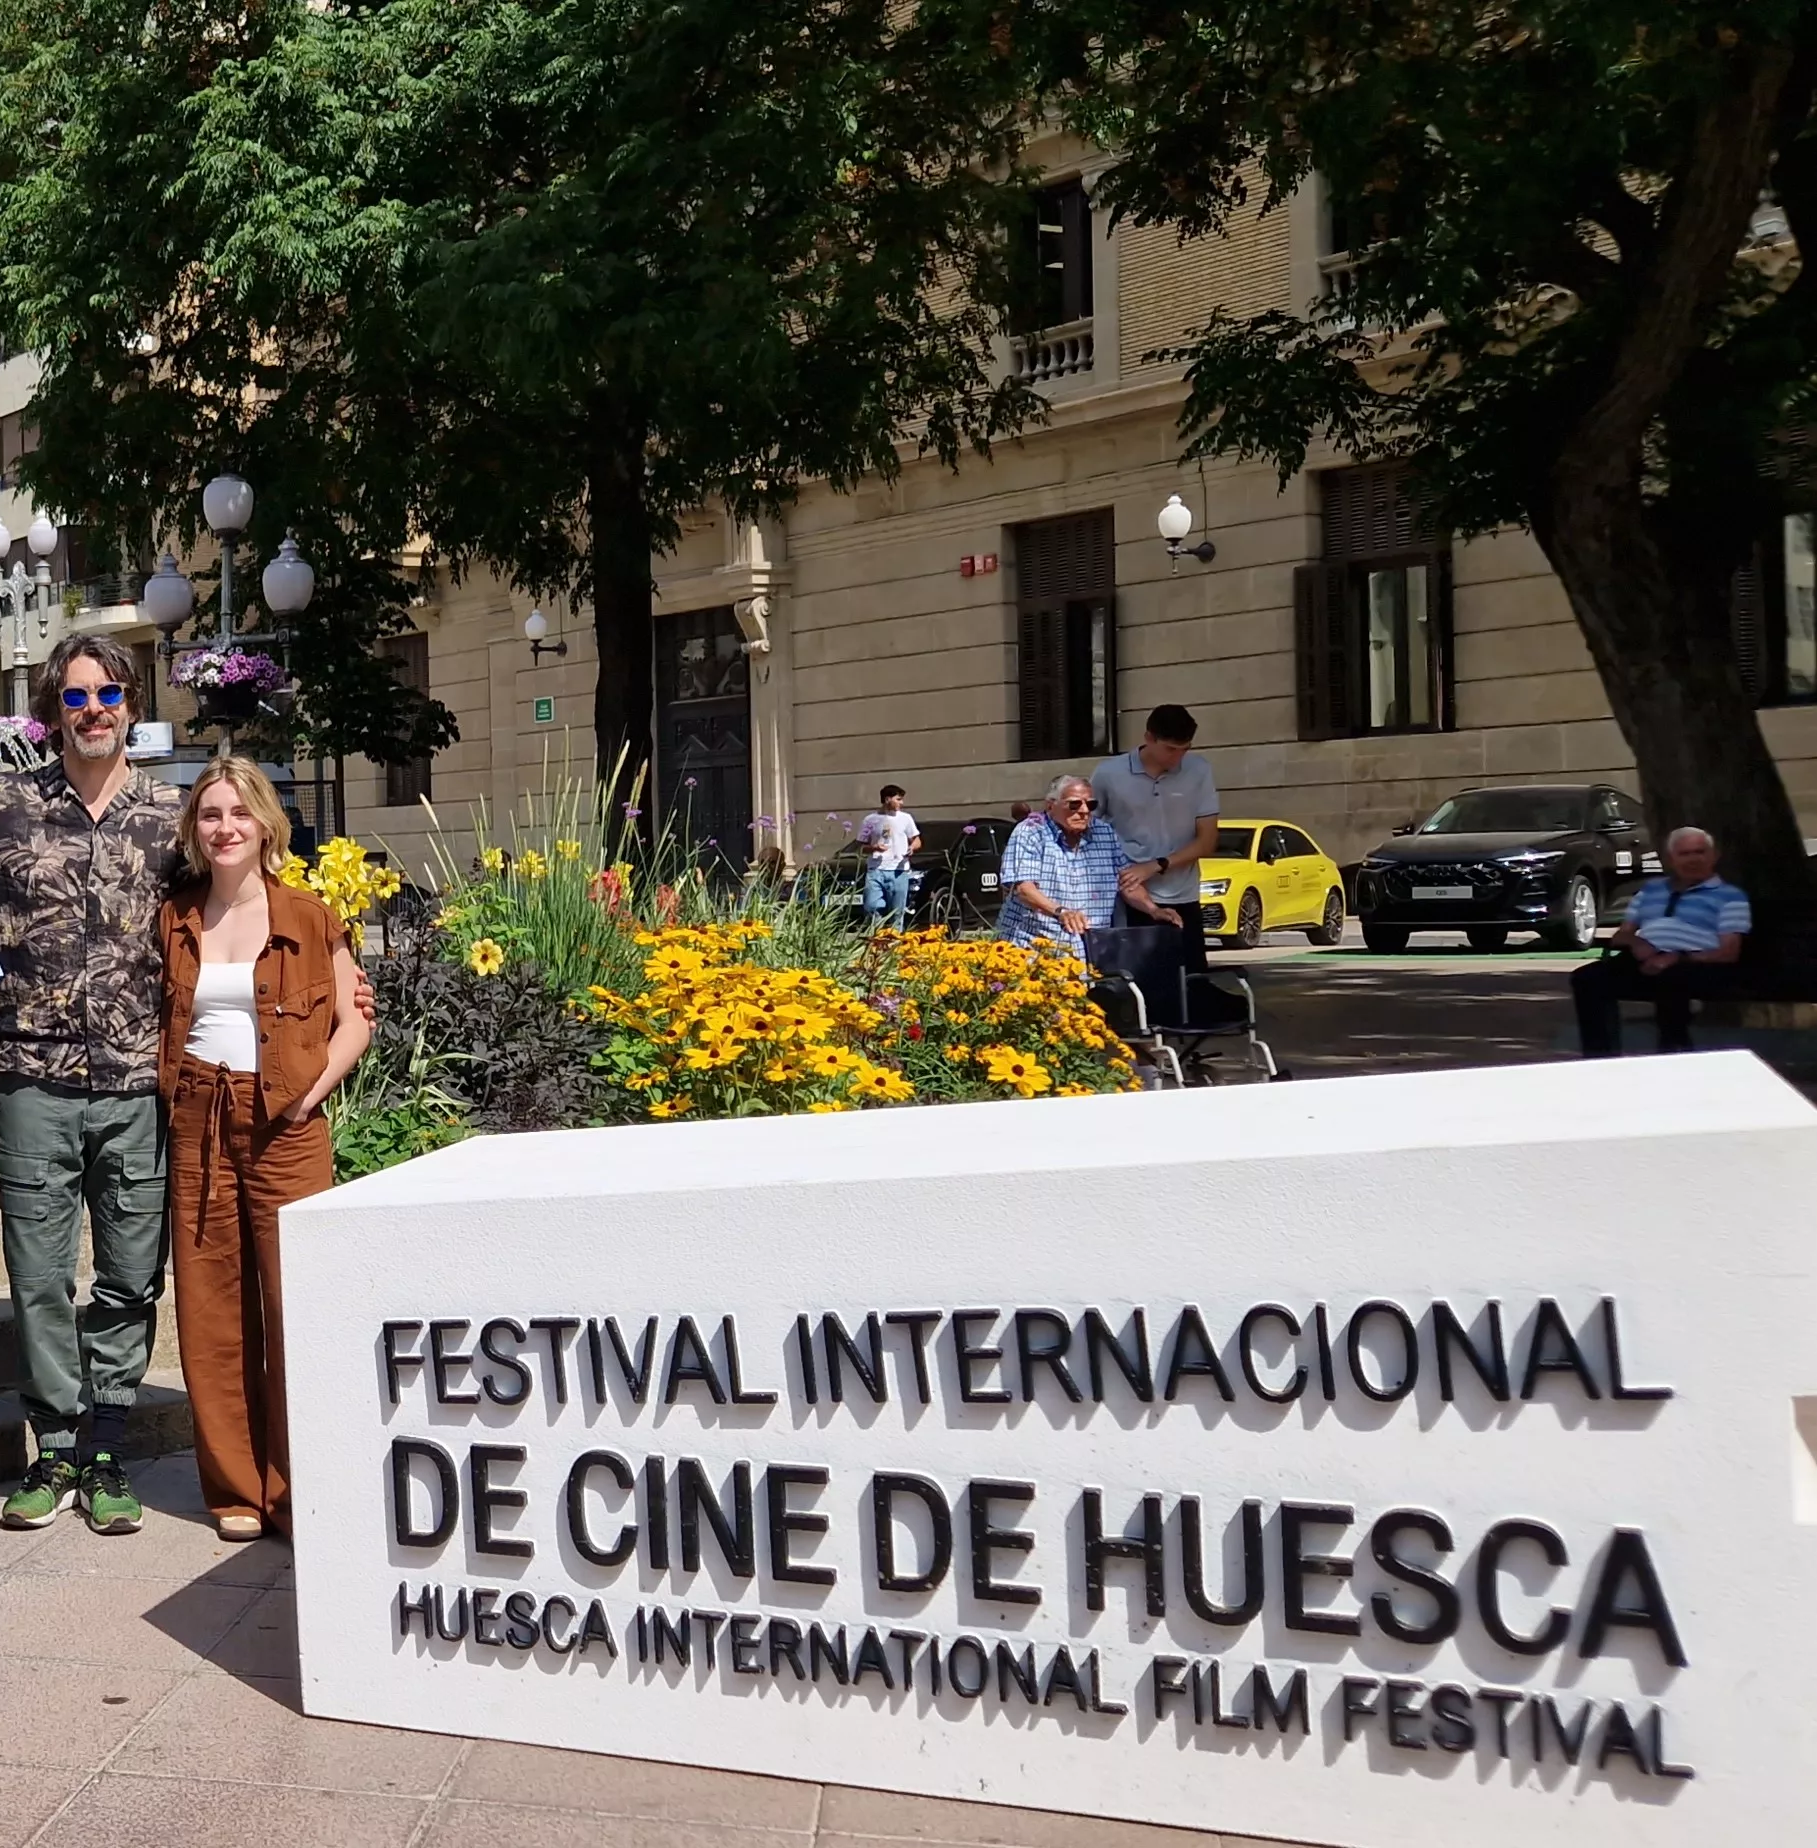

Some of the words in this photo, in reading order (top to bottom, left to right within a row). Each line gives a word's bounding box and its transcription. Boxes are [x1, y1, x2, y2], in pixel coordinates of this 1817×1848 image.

[380, 1314, 779, 1407] FESTIVAL
[794, 1297, 1673, 1405] INTERNACIONAL
[389, 1436, 534, 1560] DE
[564, 1448, 837, 1588] CINE
[870, 1470, 1043, 1607] DE
[1080, 1487, 1688, 1669] HUESCA
[396, 1581, 617, 1660] HUESCA
[634, 1606, 1128, 1718] INTERNATIONAL
[1150, 1655, 1311, 1737] FILM
[1340, 1674, 1696, 1781] FESTIVAL
